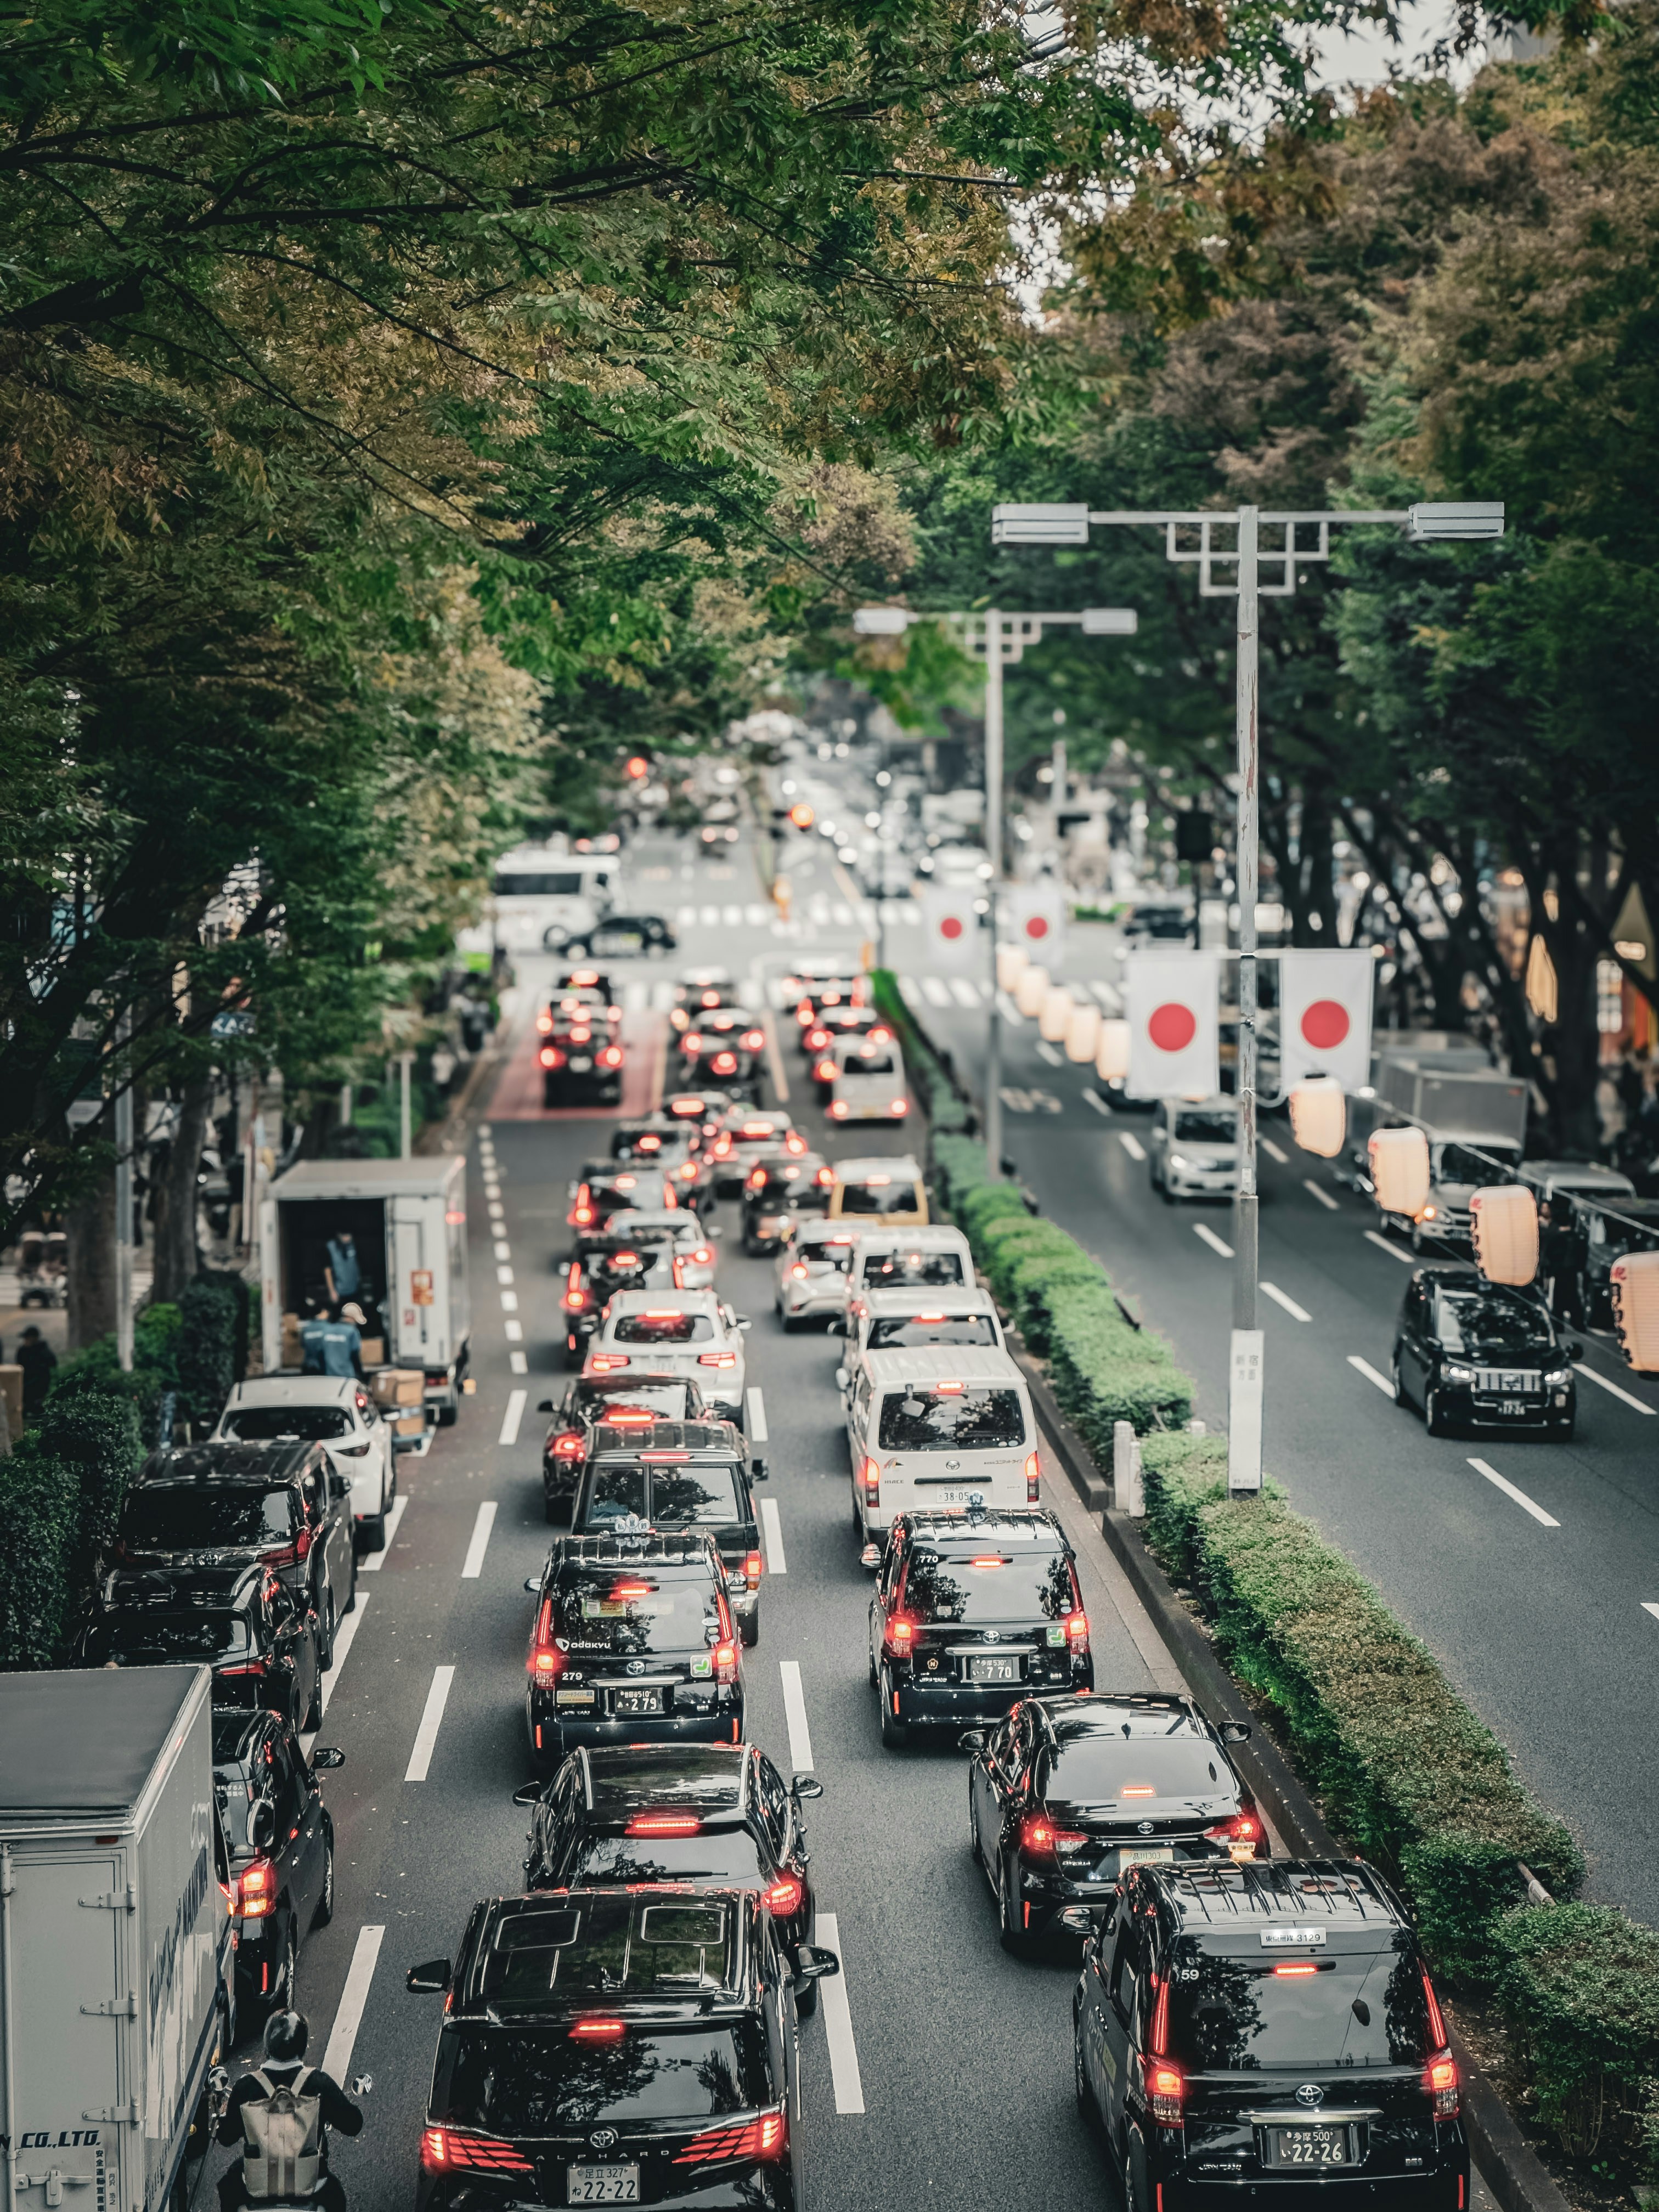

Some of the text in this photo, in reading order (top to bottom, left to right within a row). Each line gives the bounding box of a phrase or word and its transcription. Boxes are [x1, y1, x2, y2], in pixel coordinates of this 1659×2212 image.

[944, 1492, 969, 1501] 38-05
[919, 1555, 938, 1563] 770
[571, 1640, 611, 1649] odakyu
[562, 1672, 583, 1680] 279
[1297, 1934, 1320, 1942] 3129
[1181, 1969, 1199, 1980] 59
[1313, 2131, 1330, 2141] 500
[536, 2149, 669, 2160] ALPHARD
[1292, 2142, 1342, 2162] 22-26
[585, 2168, 624, 2179] 足立 327
[572, 2180, 636, 2200] ね 22-22
